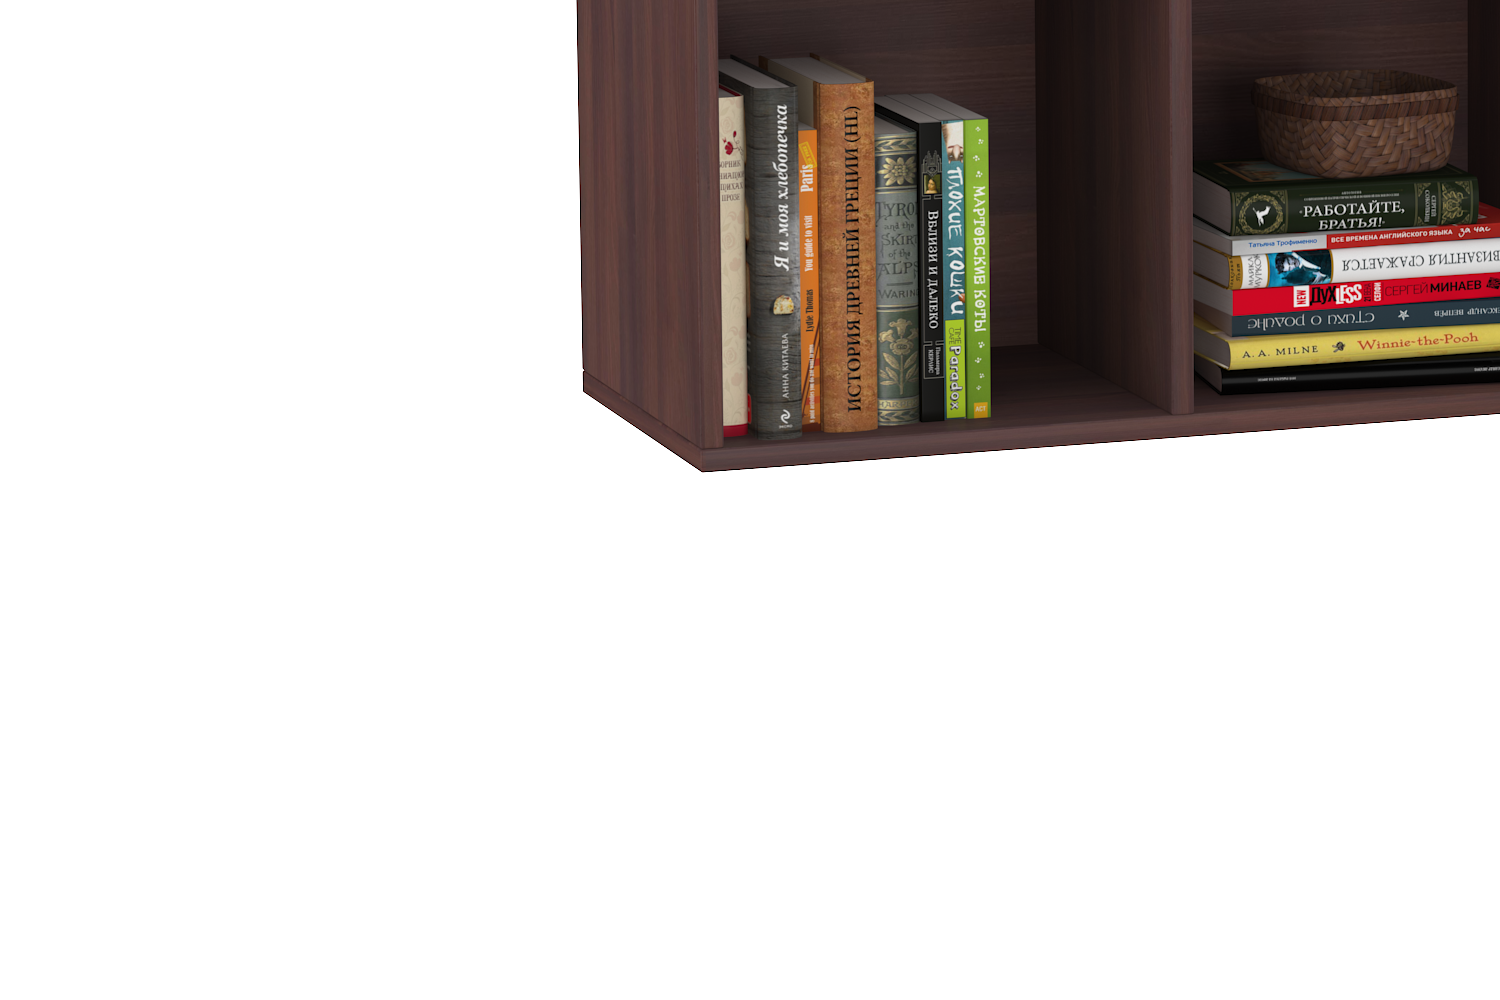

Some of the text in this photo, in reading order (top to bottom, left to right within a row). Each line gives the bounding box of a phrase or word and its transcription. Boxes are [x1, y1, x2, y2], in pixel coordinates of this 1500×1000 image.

[772, 103, 789, 272] Я и моя хлебопечка
[800, 164, 814, 193] Paris
[845, 147, 862, 224] ГРЕЦИИ
[884, 221, 914, 231] and the
[1345, 233, 1378, 242] ВРЕМЕНА
[1379, 230, 1428, 240] АНГЛИЙСКОГО
[1428, 229, 1453, 237] ЯЗЫКА
[1458, 226, 1471, 238] за
[1473, 225, 1492, 233] час
[804, 215, 814, 272] You guide to visit
[888, 248, 911, 259] of the
[1276, 238, 1318, 247] Трофименко
[842, 227, 863, 314] ДРЕВНЕЙ
[973, 186, 987, 332] МАРТОВСКИЕ КОТЫ
[1342, 250, 1500, 272] ВИЗАНТИЯ СРАЖАЕТСЯ
[1296, 289, 1307, 305] NEW
[1373, 282, 1382, 302] СЕЛФИ
[1384, 280, 1482, 297] СЕРГЕЙ МИНАЕВ
[805, 289, 815, 332] Lydie Thomas
[927, 278, 939, 329] ДАЛЕКО
[954, 327, 962, 345] TIME
[1357, 332, 1479, 351] Winnie-the-Pooh
[1242, 345, 1319, 358] A. A. MILNE
[781, 333, 790, 399] АННА КИТАЕВА
[847, 319, 861, 413] ИСТОРИЯ
[949, 345, 963, 411] Paradox
